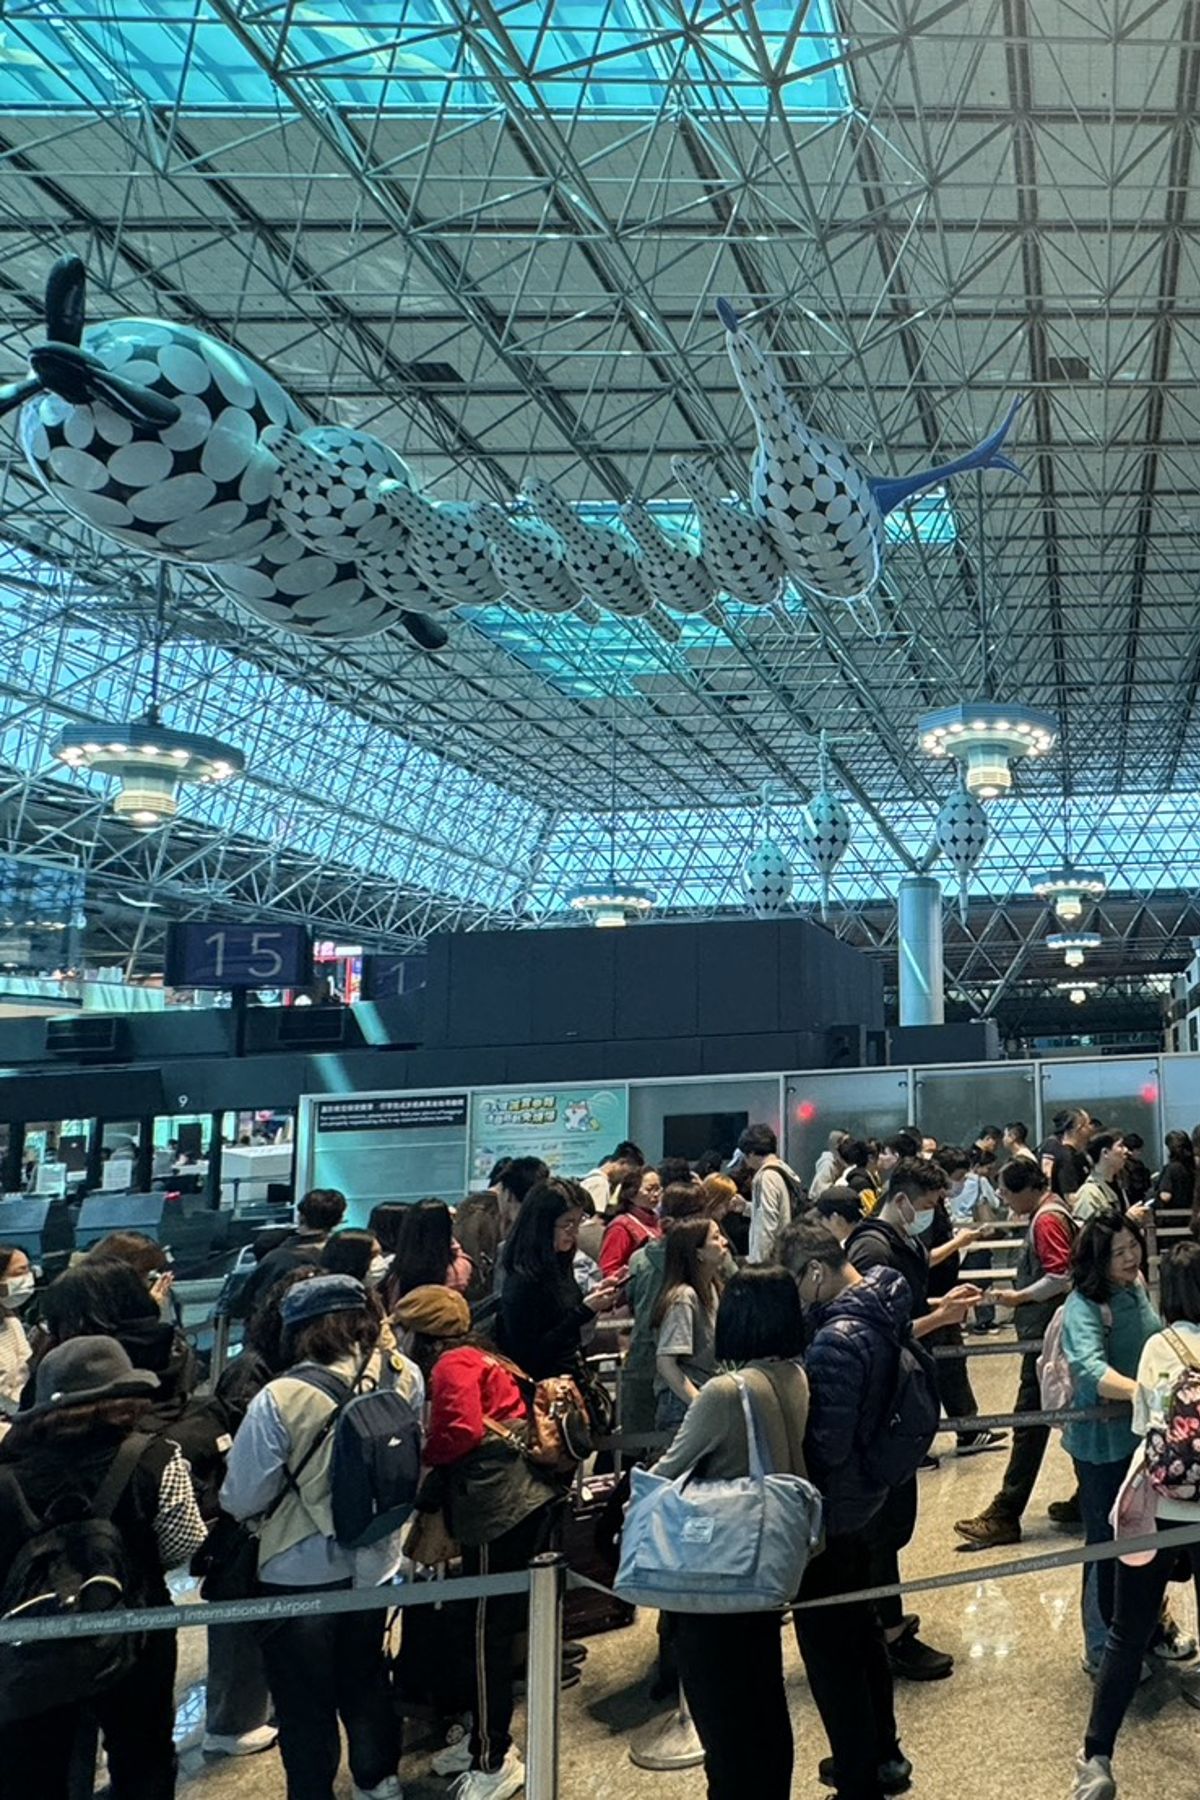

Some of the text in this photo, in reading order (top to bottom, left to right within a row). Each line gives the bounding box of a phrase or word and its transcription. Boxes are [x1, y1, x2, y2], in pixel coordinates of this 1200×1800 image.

[205, 932, 284, 977] 15
[178, 1095, 188, 1107] 9
[75, 1613, 121, 1632] Taiwan
[124, 1610, 181, 1631] Taoyuan
[184, 1603, 270, 1622] International
[273, 1597, 322, 1616] Airport
